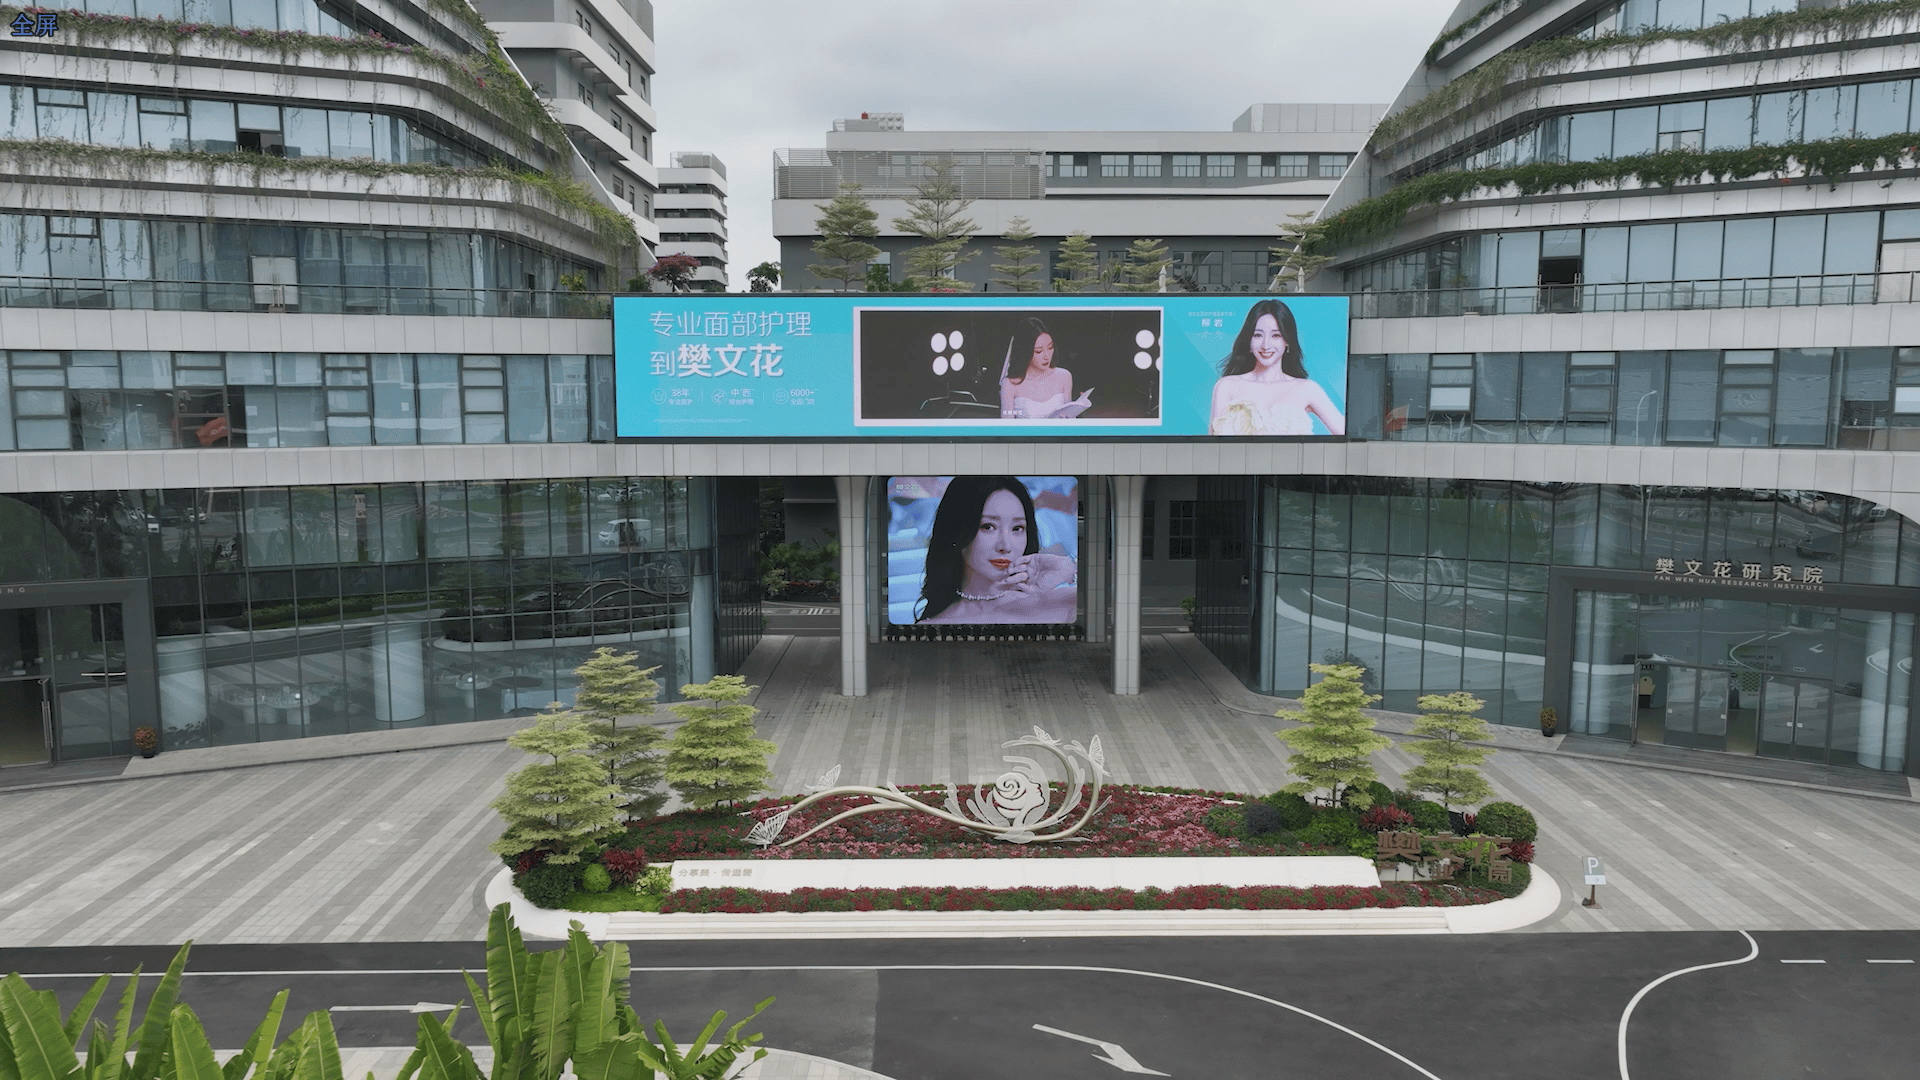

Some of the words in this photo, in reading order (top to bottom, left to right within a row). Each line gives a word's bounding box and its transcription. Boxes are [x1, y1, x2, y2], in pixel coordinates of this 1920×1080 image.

[649, 310, 812, 337] 专业面部护理
[650, 343, 784, 377] 到樊文花
[790, 388, 815, 397] 6000+
[1655, 557, 1824, 584] 樊文花研究院
[1721, 579, 1769, 588] RESEARCH
[1773, 583, 1824, 592] INSTITUTE
[1587, 856, 1599, 875] P
